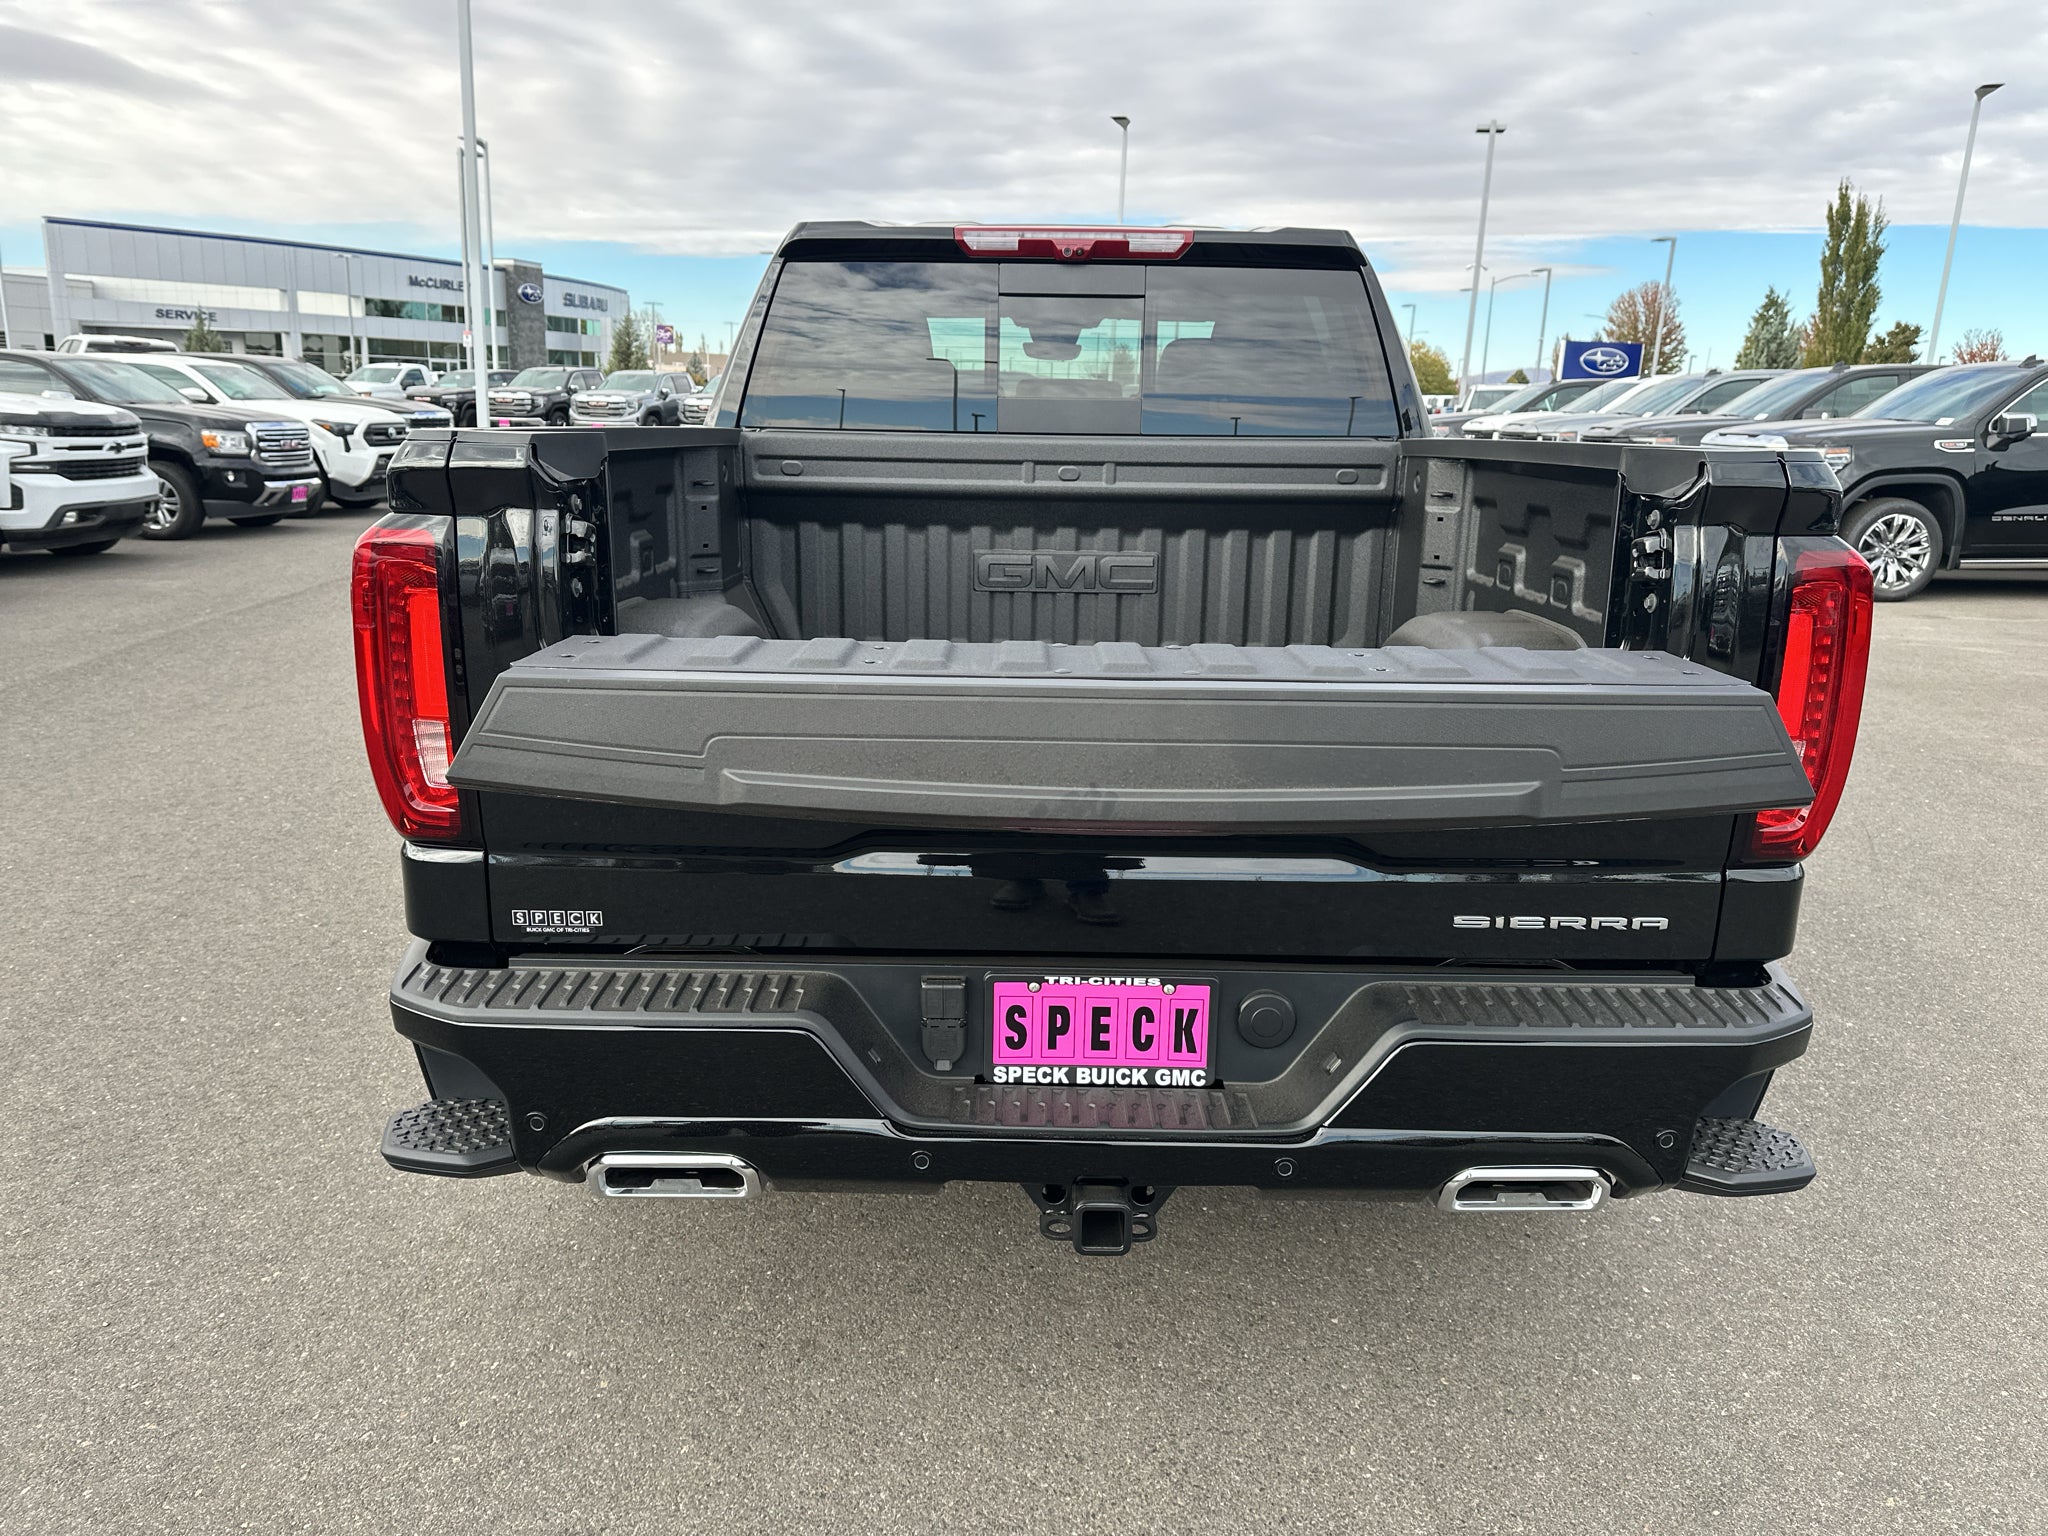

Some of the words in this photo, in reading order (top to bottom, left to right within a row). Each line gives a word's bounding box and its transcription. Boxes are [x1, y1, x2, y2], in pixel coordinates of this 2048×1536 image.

[408, 275, 465, 292] McCURLE
[563, 292, 608, 312] SUBARU
[155, 308, 218, 322] SERVICE
[979, 555, 1154, 590] GMC
[515, 912, 599, 924] SPECK
[1453, 915, 1668, 930] SIERRA
[1044, 976, 1161, 987] TRI-CITIES
[1004, 1004, 1198, 1053] SPECK
[992, 1066, 1069, 1084] SPECK
[1076, 1067, 1148, 1085] BUICK
[1155, 1068, 1206, 1086] GMC
